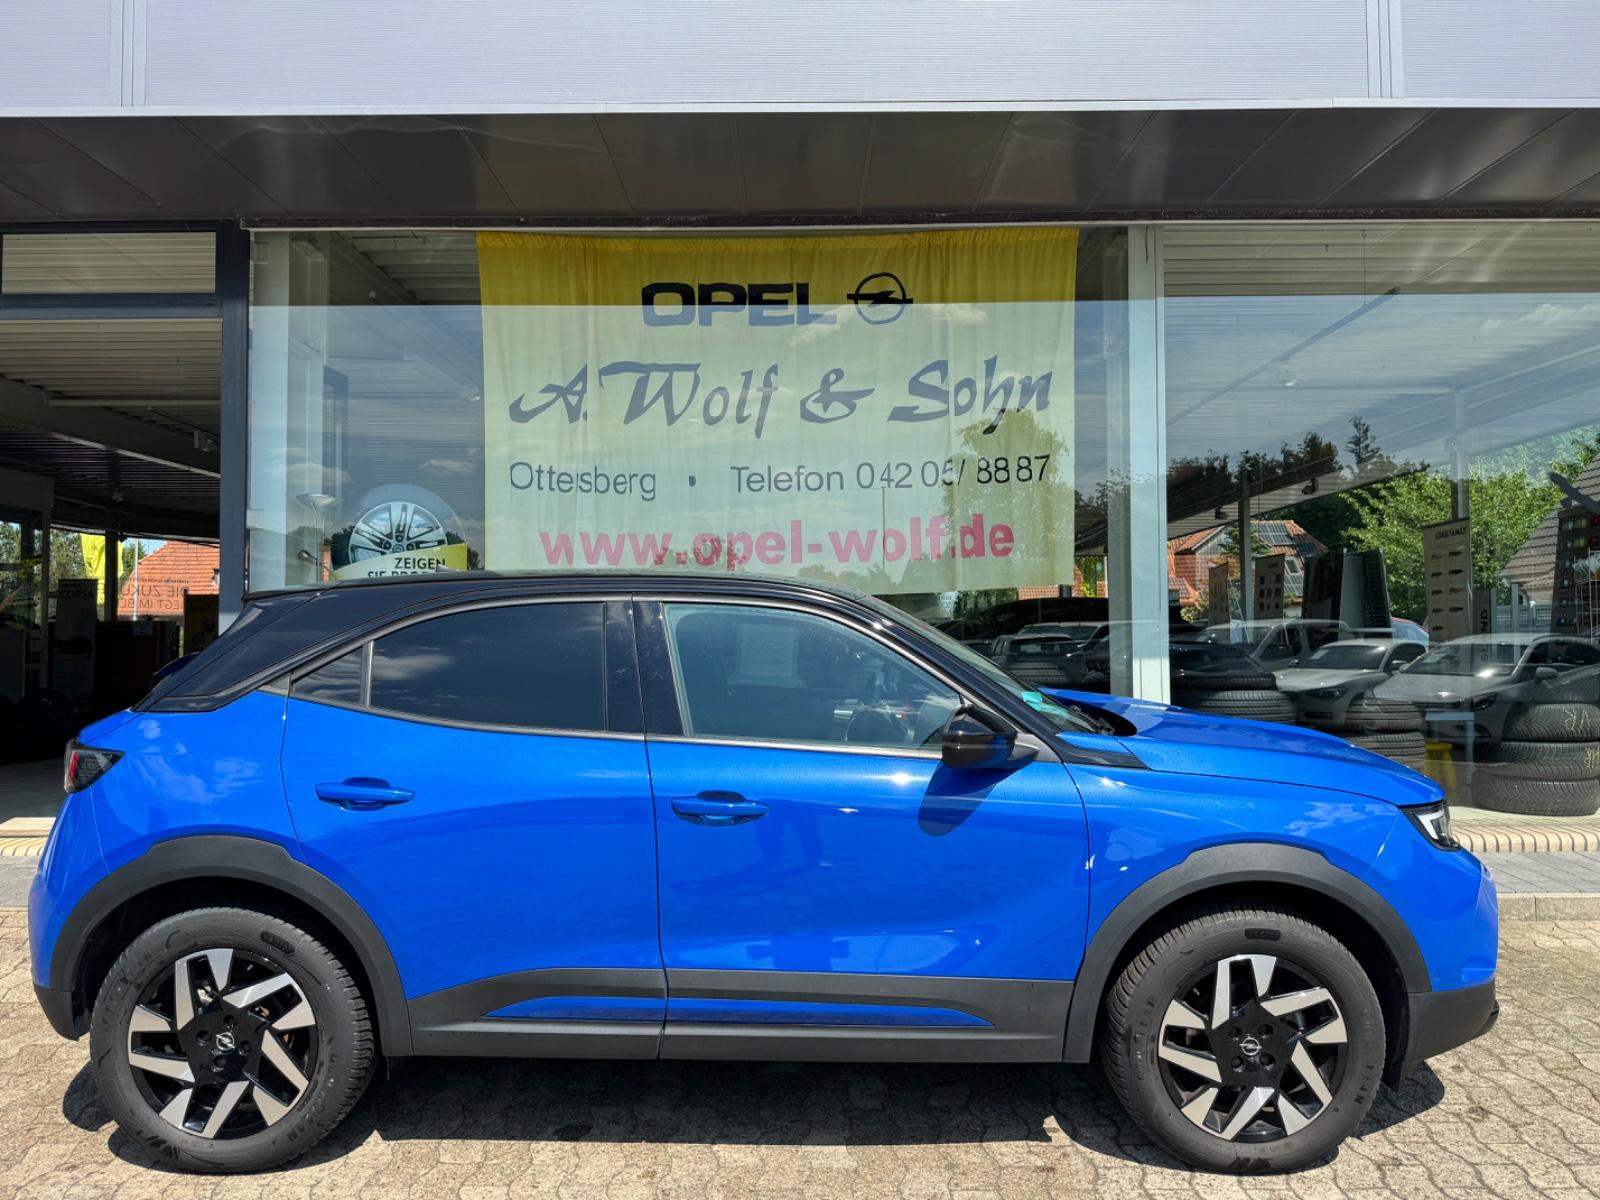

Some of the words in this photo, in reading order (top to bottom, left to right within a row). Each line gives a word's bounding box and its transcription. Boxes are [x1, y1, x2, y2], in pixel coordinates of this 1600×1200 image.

[641, 282, 837, 327] OPEL
[508, 363, 588, 424] A.
[598, 360, 779, 440] Wolf
[800, 368, 876, 424] &
[887, 355, 1053, 435] Sohn
[510, 461, 657, 502] Ottesberg
[730, 464, 845, 493] Telefon
[395, 557, 446, 570] ZEIGEN
[540, 515, 1014, 571] www.opel-wolf.de
